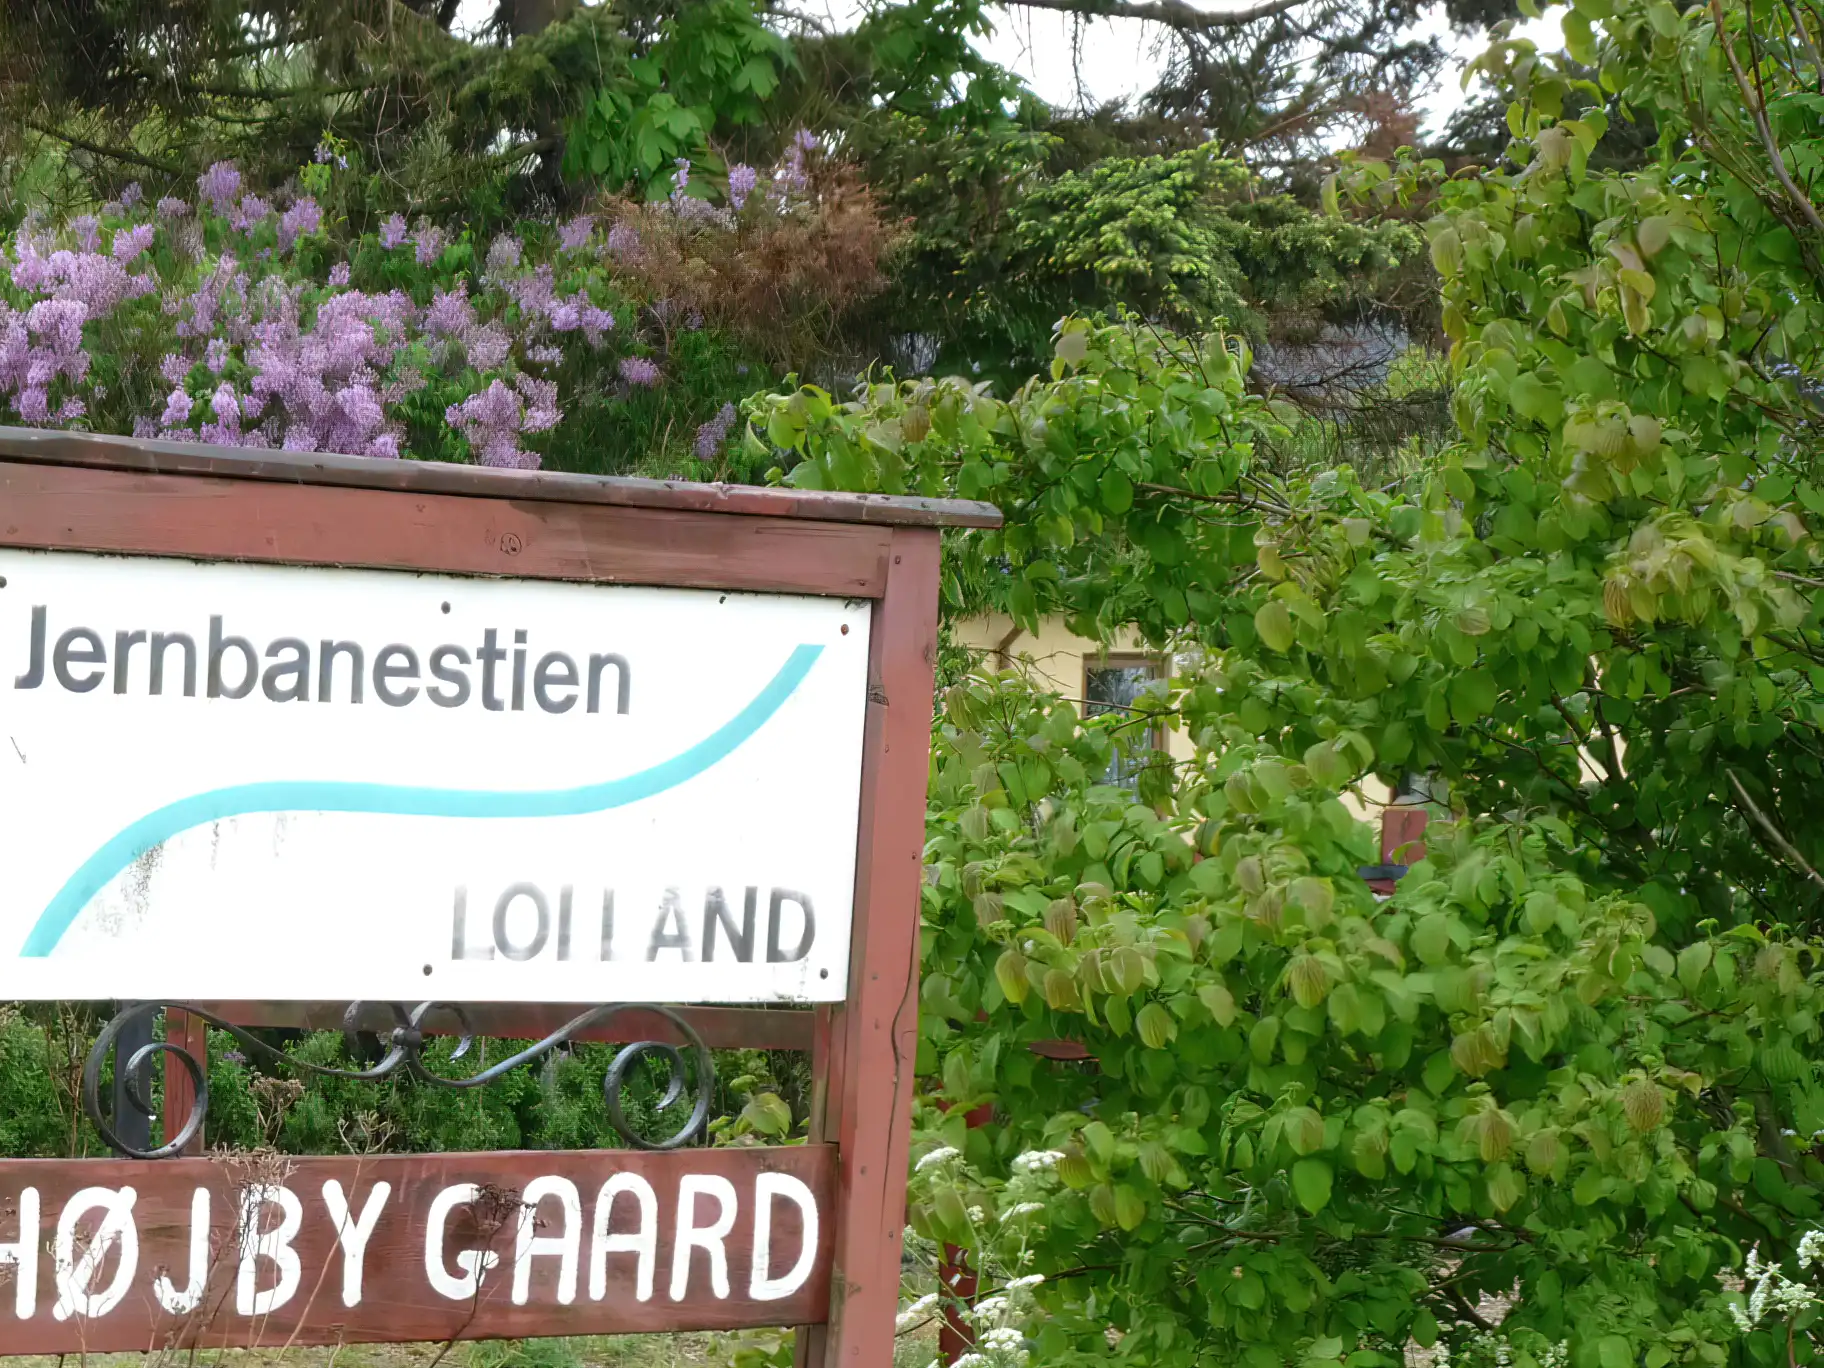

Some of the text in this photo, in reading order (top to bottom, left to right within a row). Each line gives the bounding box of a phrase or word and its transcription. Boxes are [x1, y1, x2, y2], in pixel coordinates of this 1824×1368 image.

[14, 604, 631, 716] Jernbanestien
[450, 881, 817, 964] LOLLAND
[424, 1171, 819, 1307] GAARD
